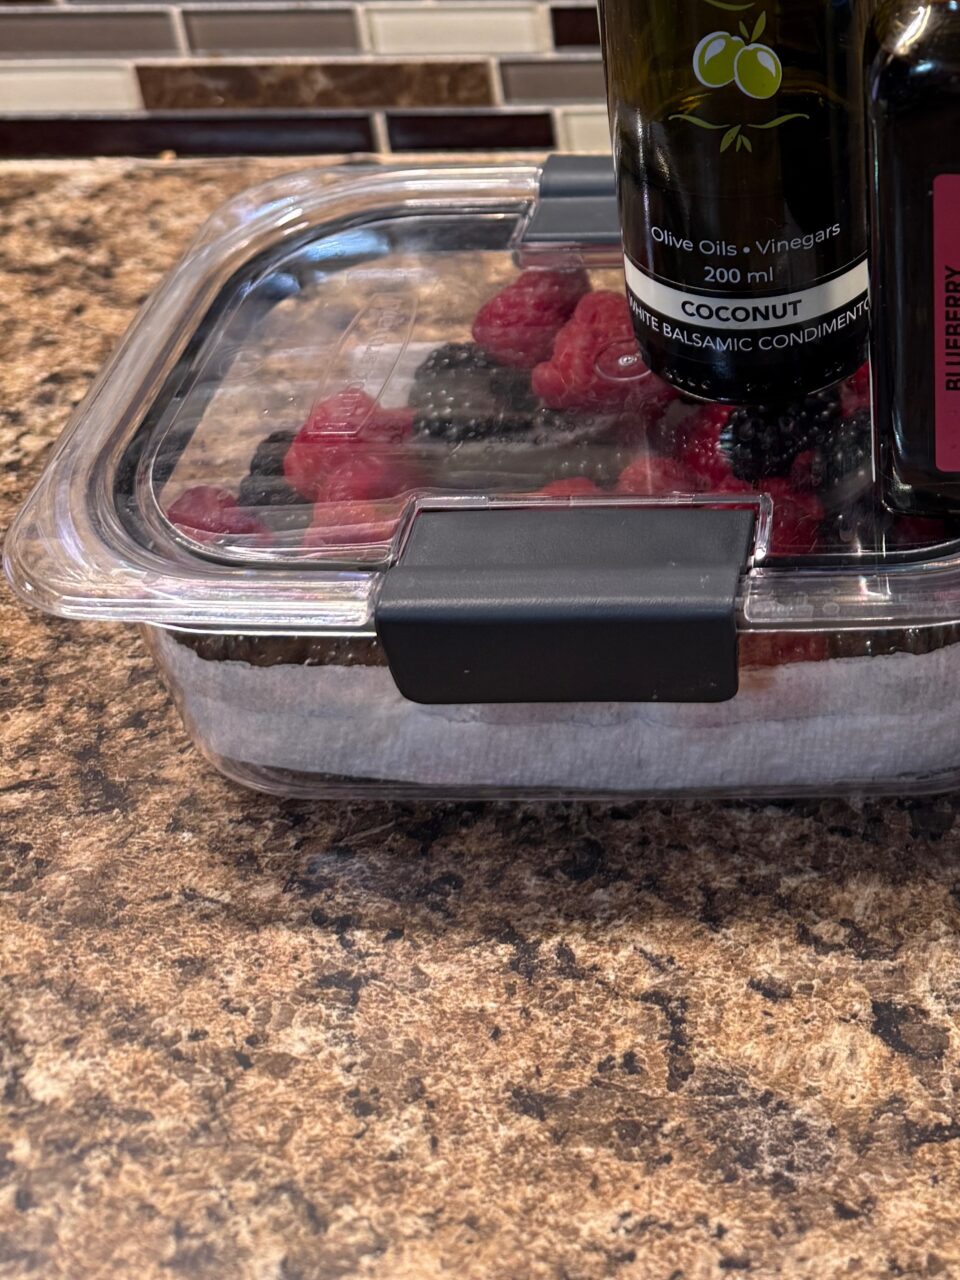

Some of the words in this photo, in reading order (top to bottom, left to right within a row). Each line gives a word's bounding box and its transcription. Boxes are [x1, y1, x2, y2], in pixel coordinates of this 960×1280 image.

[651, 226, 694, 252] Olive
[699, 240, 738, 256] Oils
[755, 223, 841, 255] Vinegars
[704, 266, 741, 283] 200
[748, 266, 774, 283] ml
[681, 300, 802, 323] COCONUT
[663, 322, 753, 351] BALSAMIC
